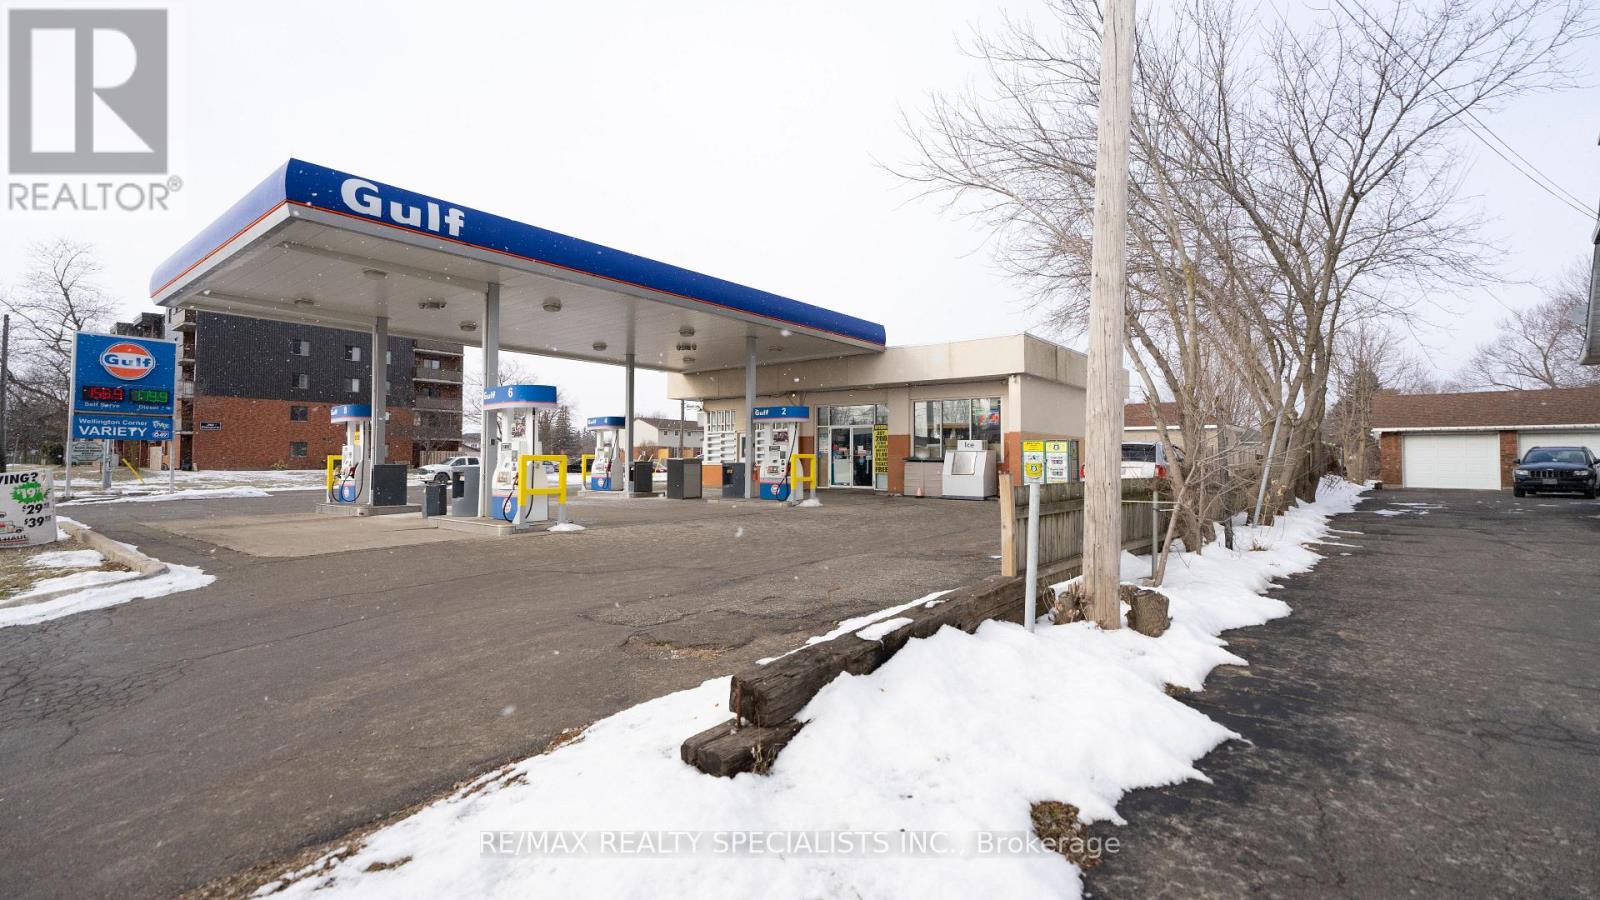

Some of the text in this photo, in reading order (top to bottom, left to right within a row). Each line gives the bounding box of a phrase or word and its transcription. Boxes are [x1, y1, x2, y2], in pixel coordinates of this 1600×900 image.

[340, 178, 465, 237] Gulf
[104, 354, 151, 367] Gulf
[508, 387, 513, 398] 6
[79, 425, 148, 437] VARIETY
[964, 441, 975, 449] Ice
